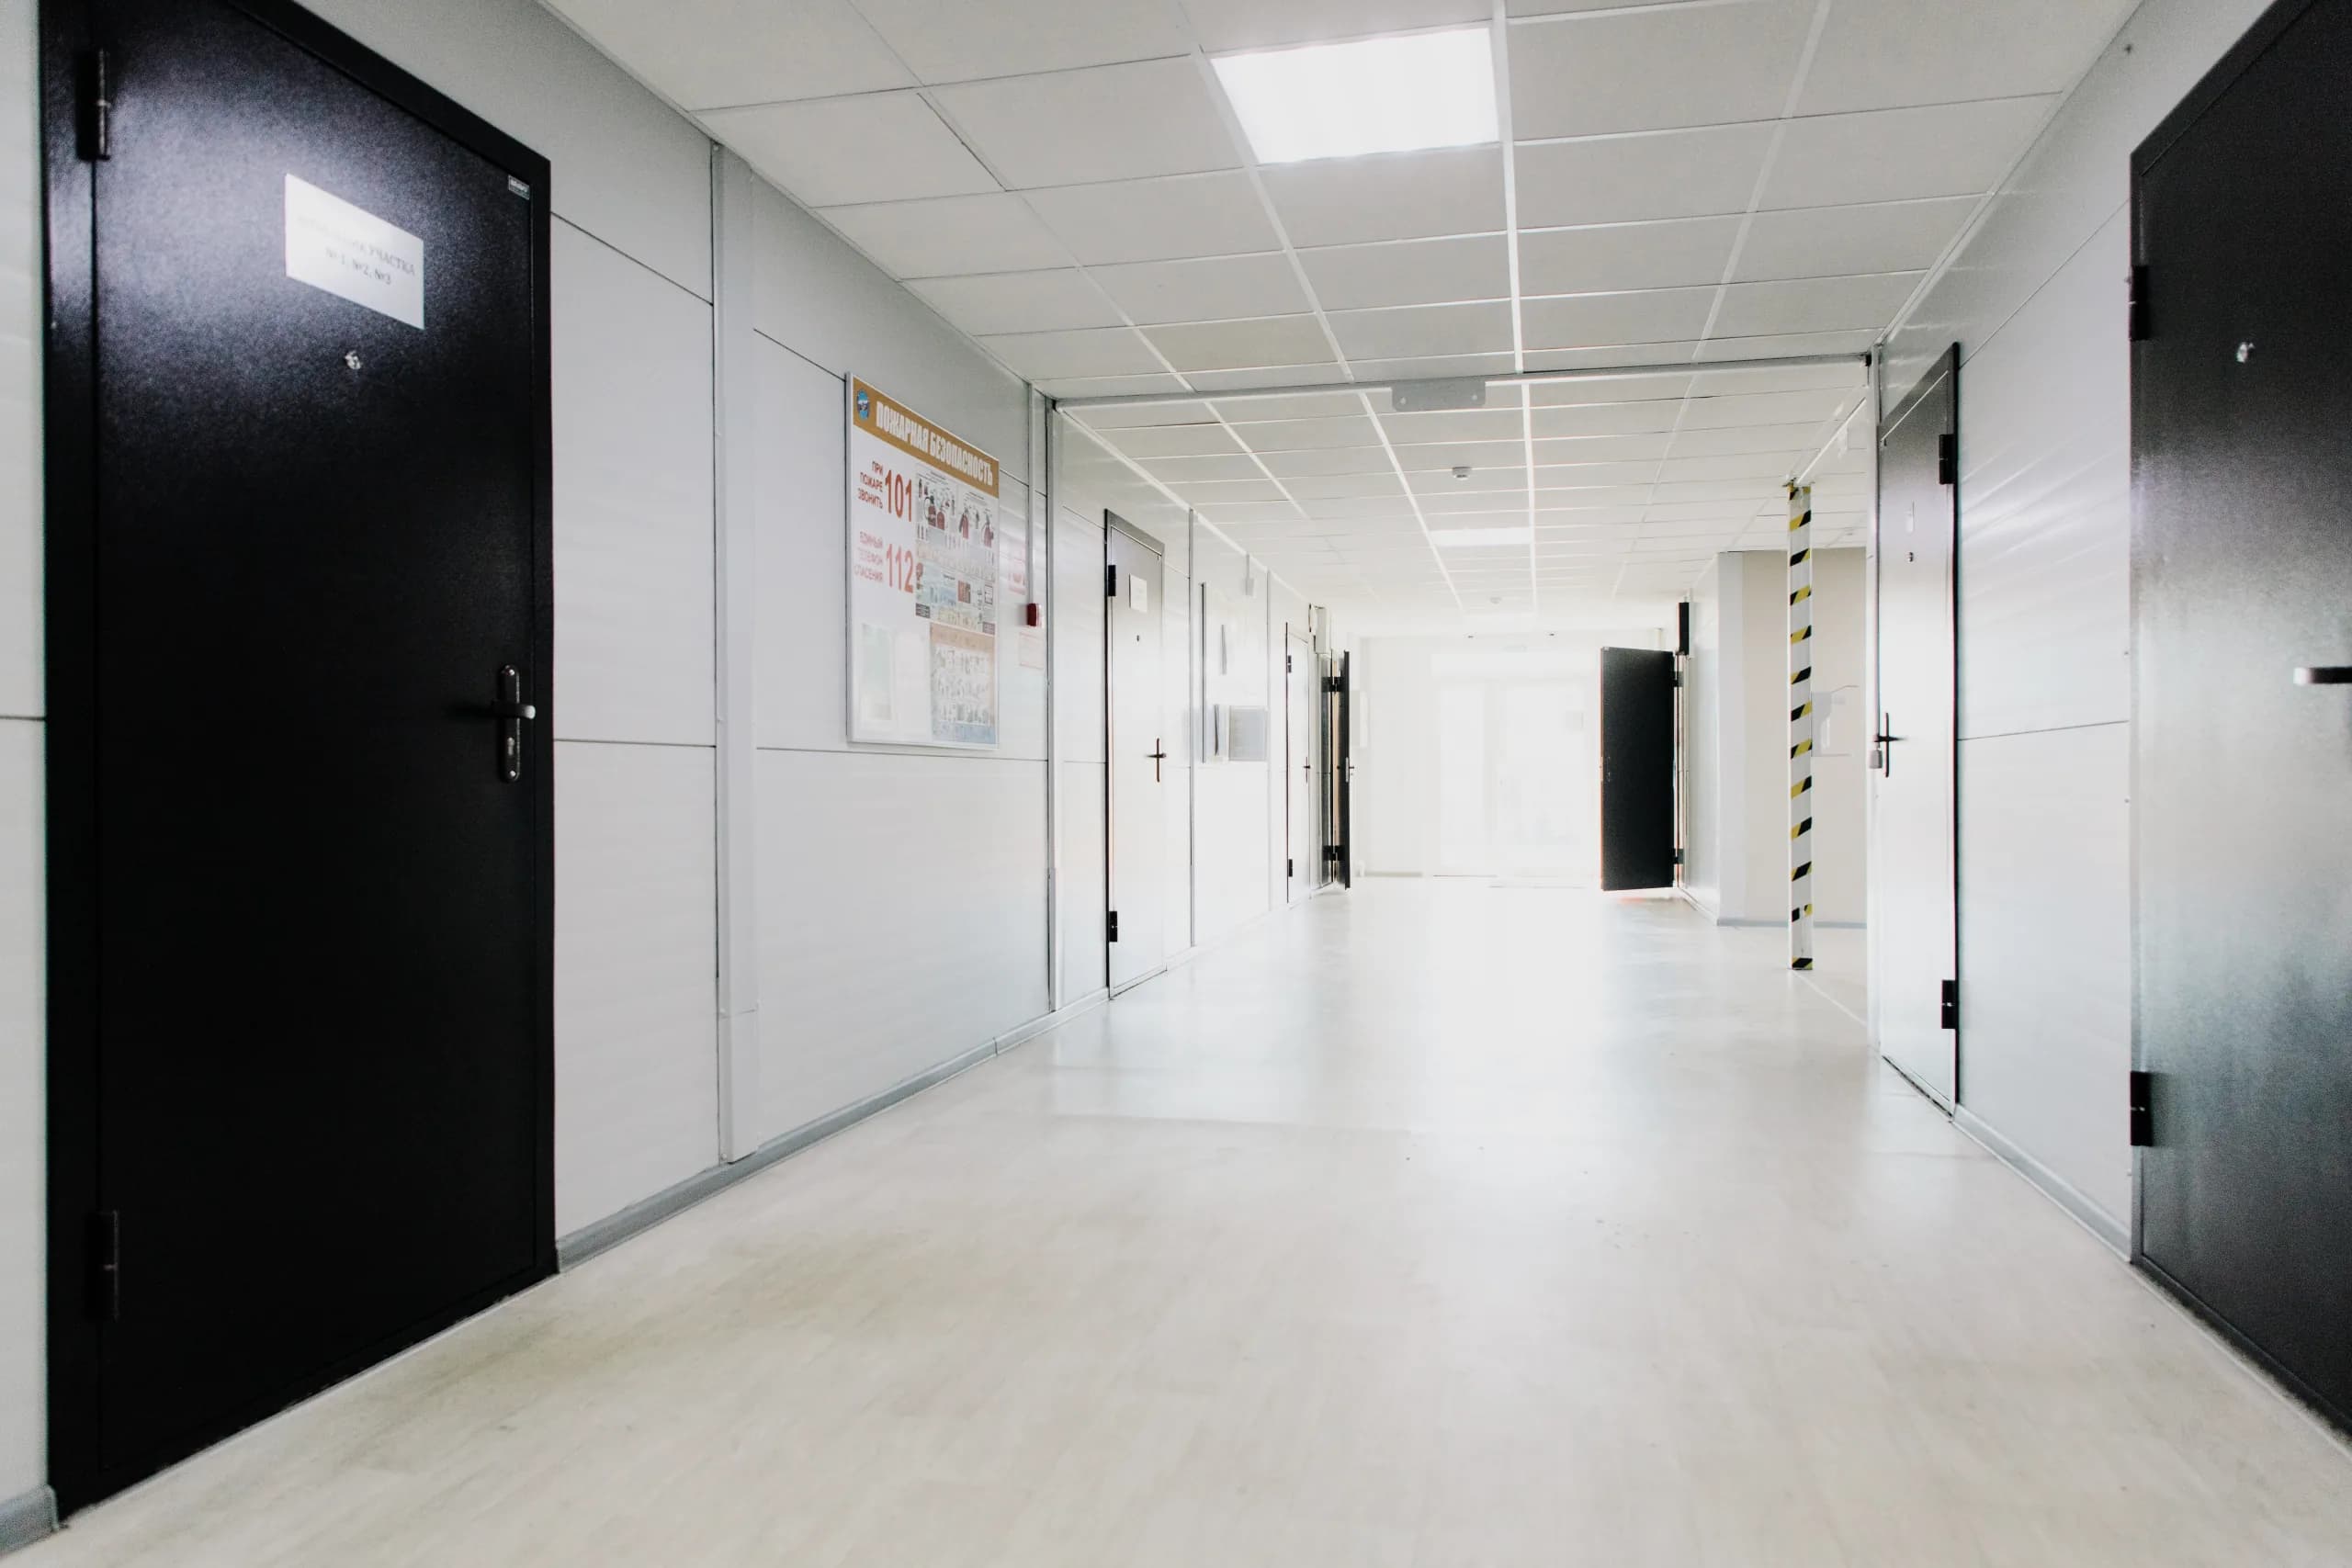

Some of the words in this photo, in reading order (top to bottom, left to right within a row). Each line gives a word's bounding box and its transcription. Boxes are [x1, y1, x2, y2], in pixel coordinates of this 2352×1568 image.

[368, 243, 415, 276] УЧАСТКА
[876, 400, 929, 454] ПОЖАРНАЯ
[929, 431, 993, 486] БЕЗОПАСНОСТЬ
[860, 472, 883, 492] ПОЖАРЕ
[872, 461, 884, 476] ПРИ
[857, 488, 883, 509] ЗВОНИТЬ
[885, 469, 912, 523] 101
[887, 543, 913, 593] 112
